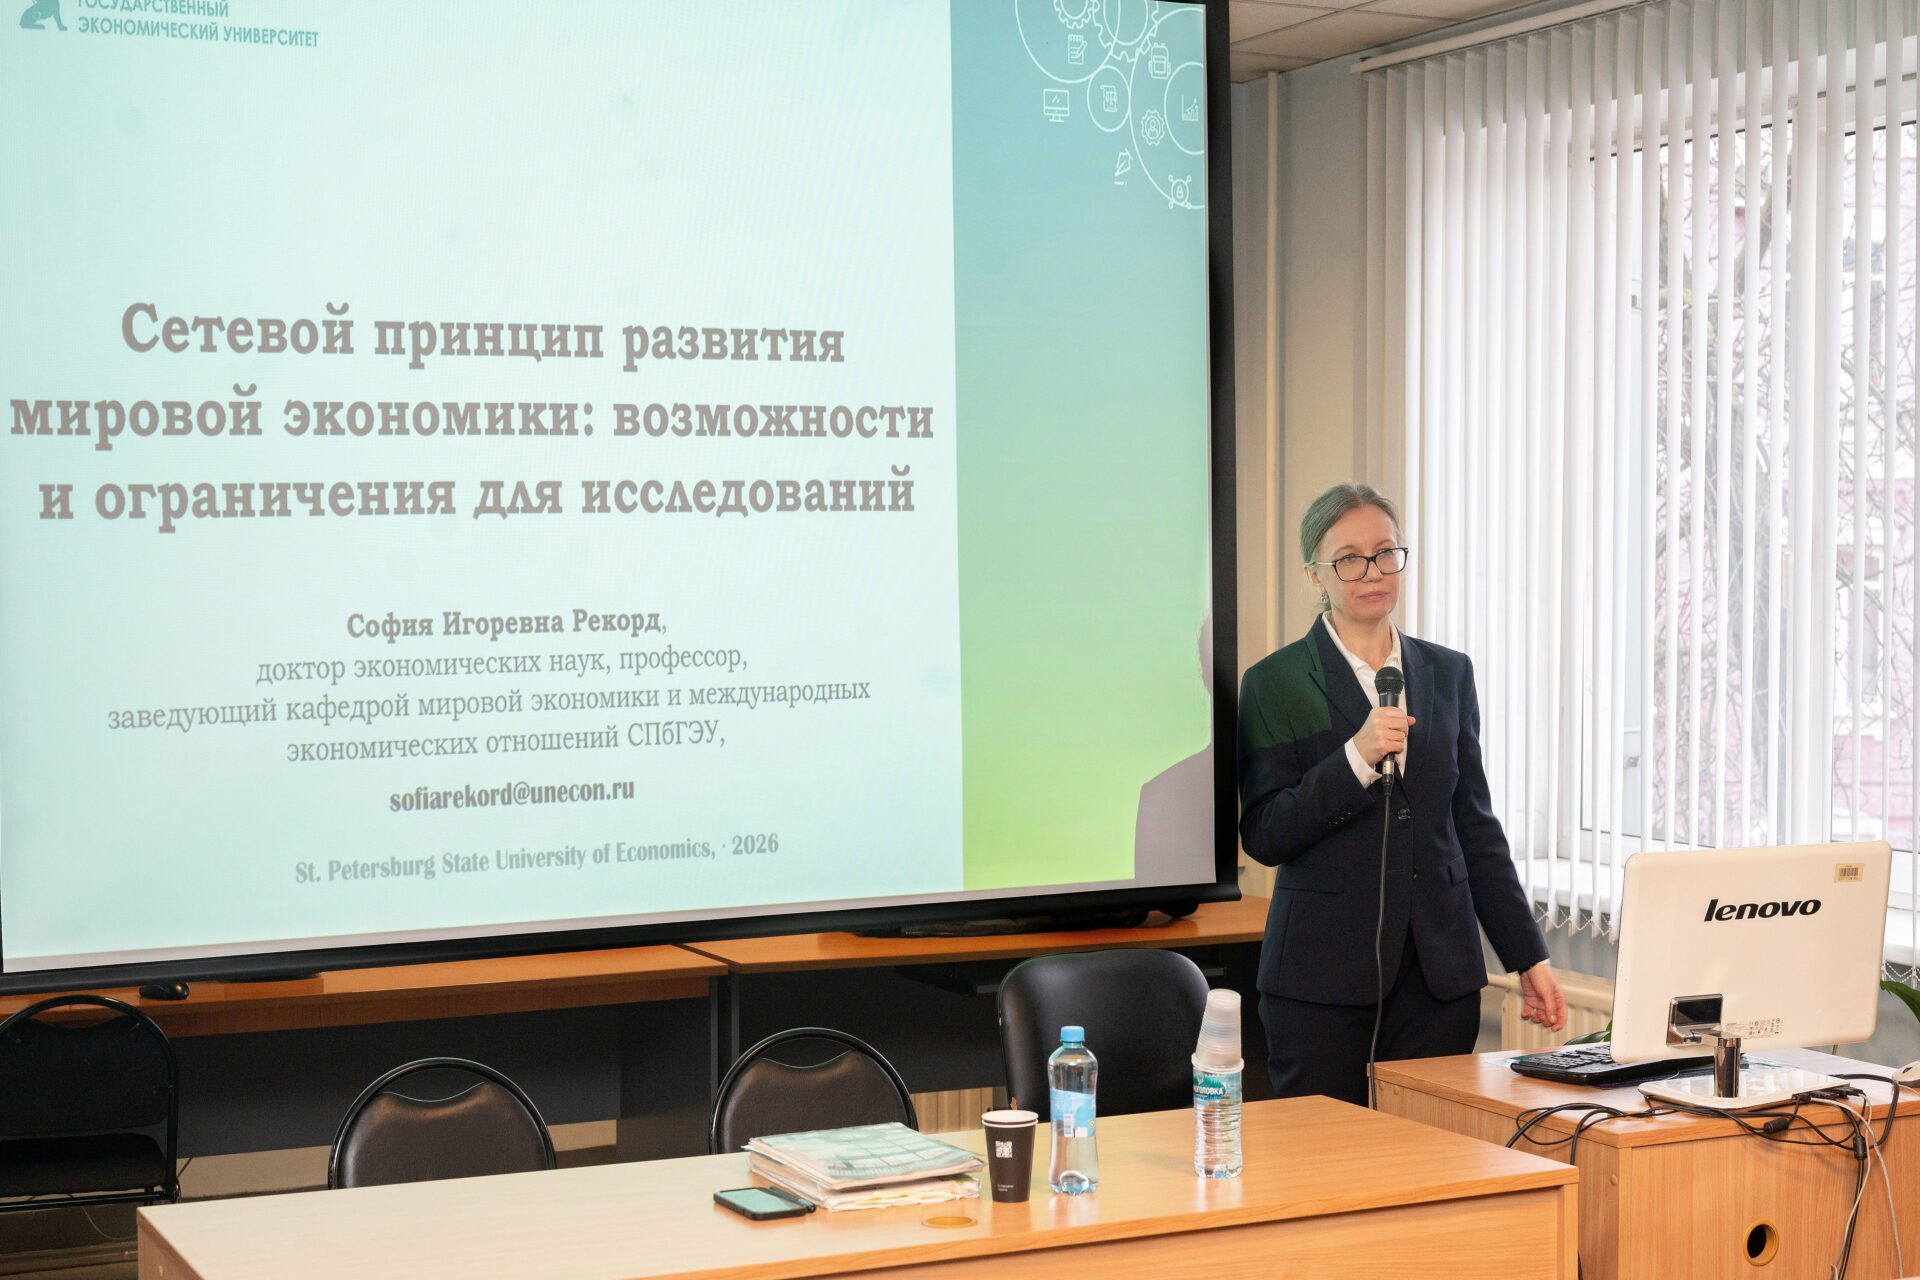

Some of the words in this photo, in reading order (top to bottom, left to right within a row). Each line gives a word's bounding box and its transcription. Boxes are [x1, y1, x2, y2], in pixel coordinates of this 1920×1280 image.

[78, 16, 219, 41] ЭКОНОМИЧЕСКИЙ
[223, 26, 319, 47] УНИВЕРСИТЕТ
[122, 302, 354, 354] Сетевой
[374, 321, 604, 369] принцип
[622, 325, 845, 372] развития
[10, 383, 262, 451] мировой
[283, 399, 593, 437] экономики:
[613, 402, 934, 438] возможности
[39, 484, 74, 519] и
[95, 481, 456, 533] ограничения
[473, 481, 562, 520] для
[581, 465, 915, 518] исследований
[347, 612, 433, 644] София
[442, 611, 564, 642] Игоревна
[572, 608, 667, 638] Рекорд,
[256, 660, 346, 686] доктор
[354, 654, 542, 679] экономических
[549, 651, 612, 678] наук,
[619, 644, 748, 676] профессор,
[107, 697, 278, 733] заведующий
[286, 693, 410, 727] кафедрой
[418, 689, 523, 722] мировой
[531, 689, 660, 712] экономики
[666, 688, 682, 707] и
[689, 682, 872, 710] международных
[286, 736, 478, 762] экономических
[486, 725, 620, 754] отношений
[628, 720, 726, 748] СПбГЭУ,
[389, 781, 635, 812] sofiarekord@unecon.ru
[295, 862, 322, 884] St.
[328, 854, 437, 882] Petersburg
[442, 851, 490, 875] State
[496, 844, 588, 871] University
[592, 842, 612, 865] of
[616, 837, 717, 863] Economics,
[731, 832, 780, 856] 2026
[1704, 899, 1822, 922] lenovo
